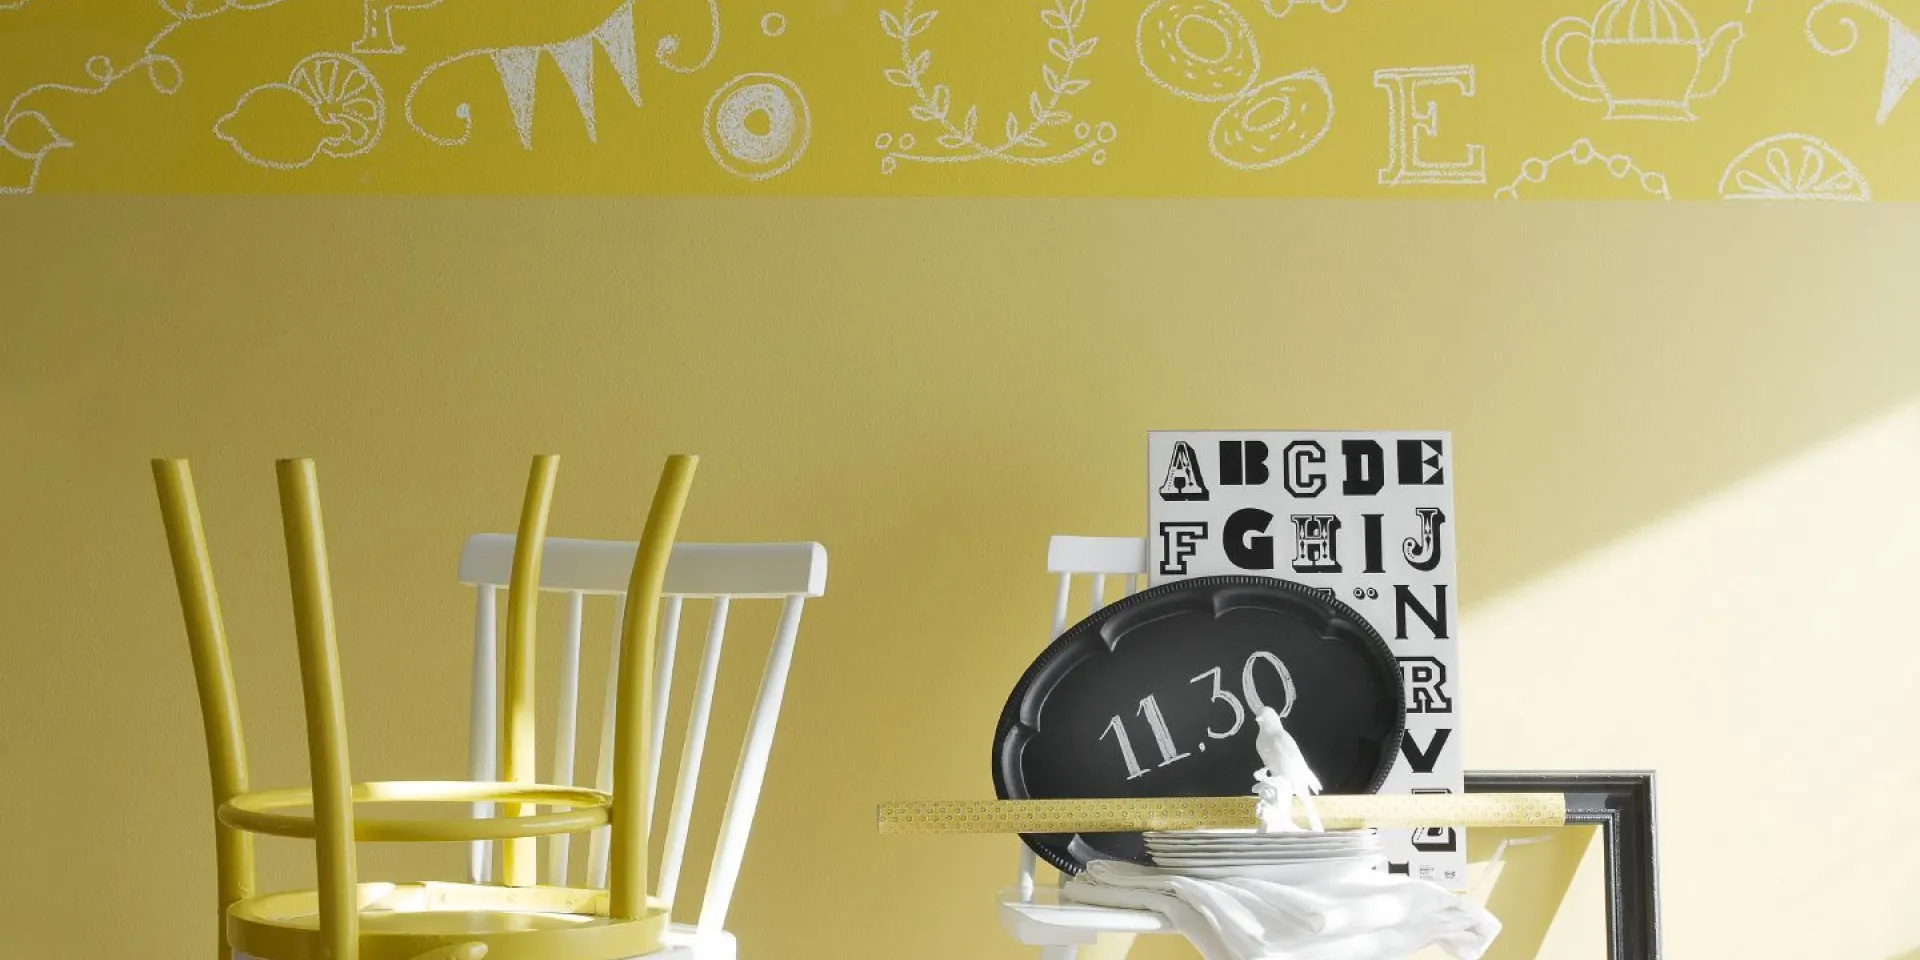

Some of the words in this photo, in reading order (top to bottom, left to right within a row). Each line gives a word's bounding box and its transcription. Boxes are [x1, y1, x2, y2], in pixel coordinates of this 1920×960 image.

[1373, 64, 1486, 185] E
[1393, 584, 1449, 640] N
[1099, 651, 1297, 780] 11.30
[1396, 656, 1452, 714] R
